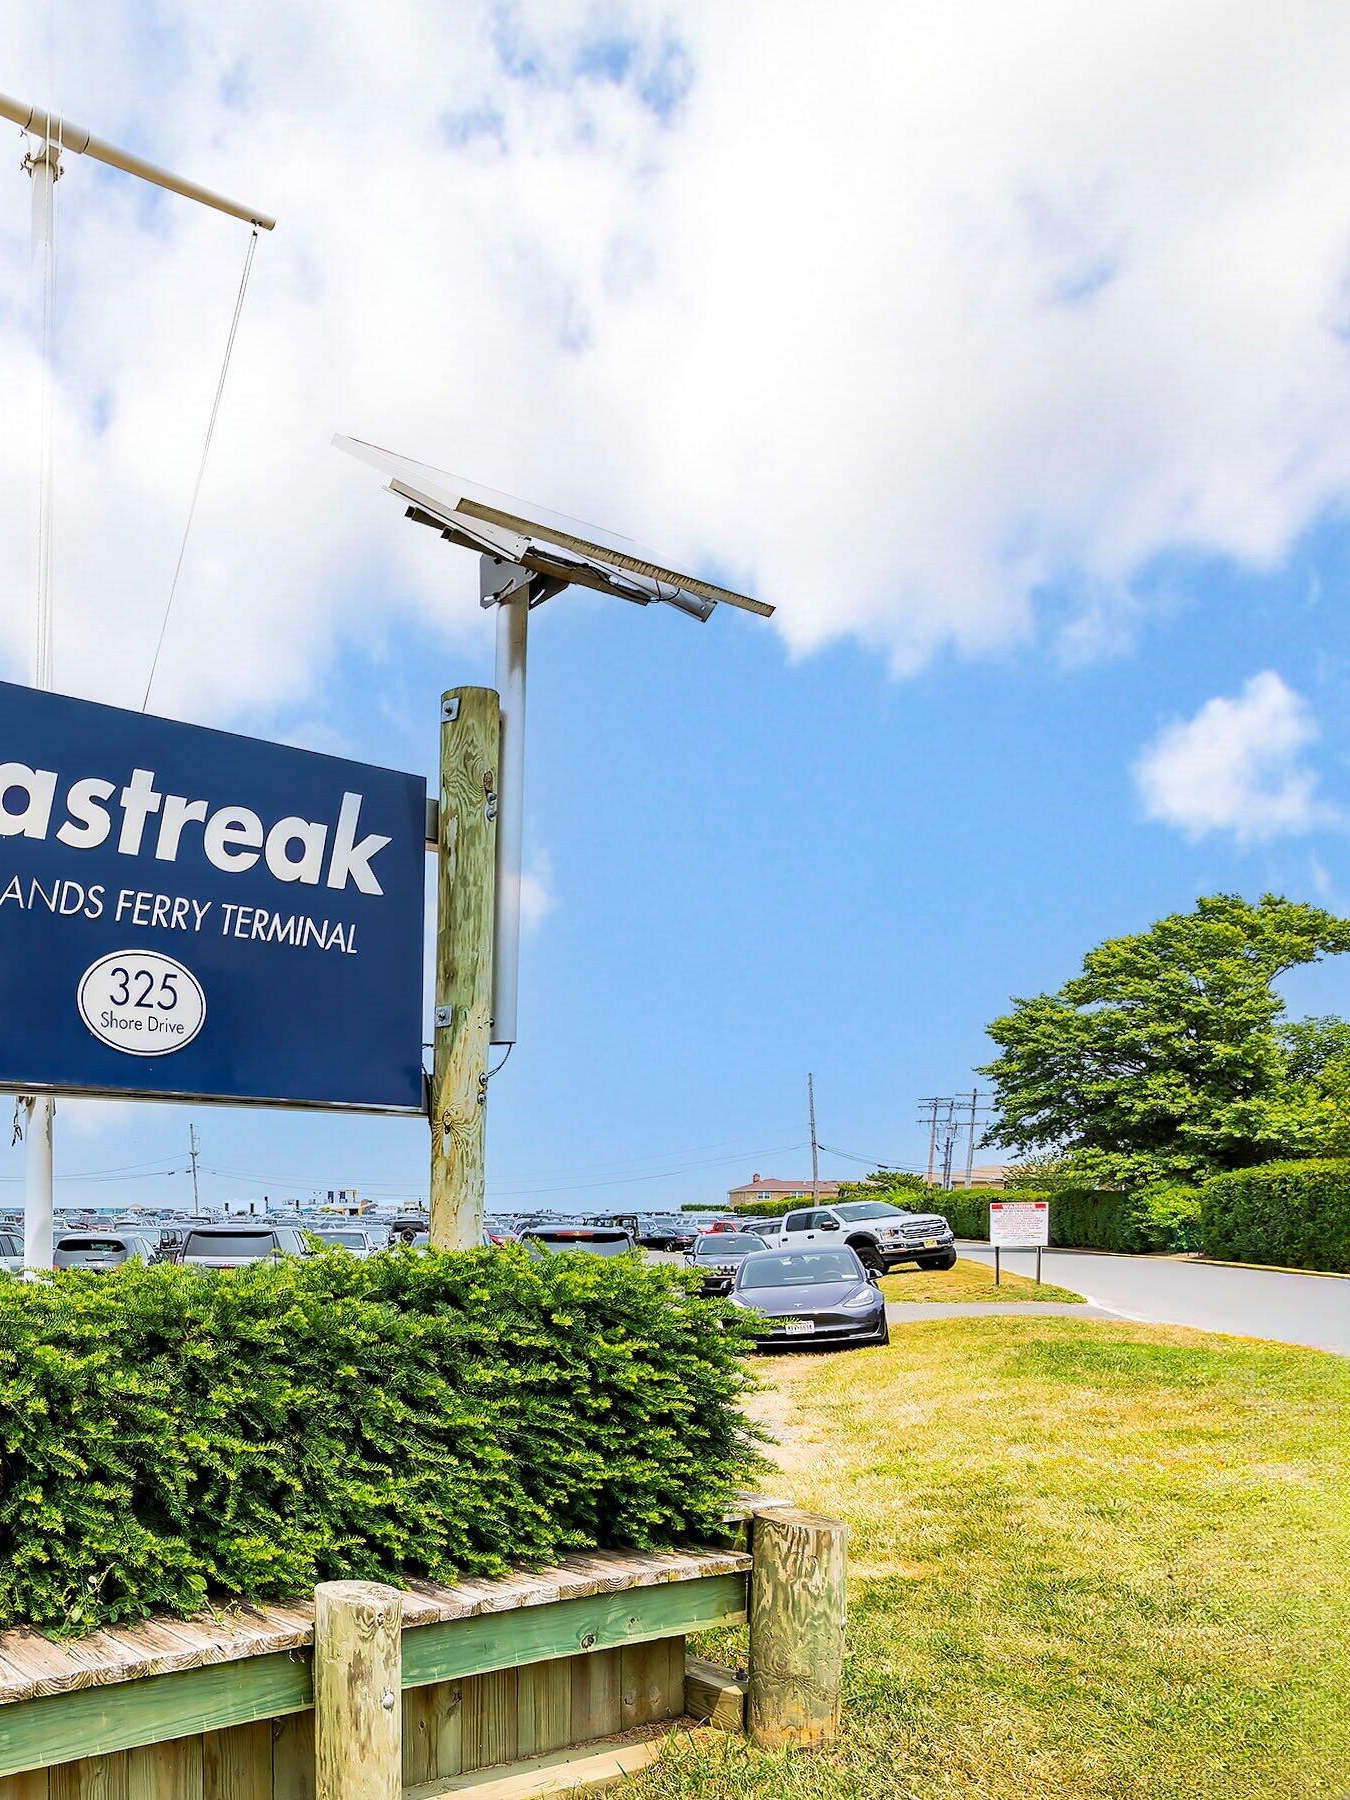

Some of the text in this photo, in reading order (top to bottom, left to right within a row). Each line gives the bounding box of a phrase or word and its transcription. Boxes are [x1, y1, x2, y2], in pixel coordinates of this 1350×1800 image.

[114, 889, 212, 932] FERRY
[221, 903, 358, 954] TERMINAL
[109, 967, 178, 1011] 325
[100, 1010, 185, 1035] Shore Drive
